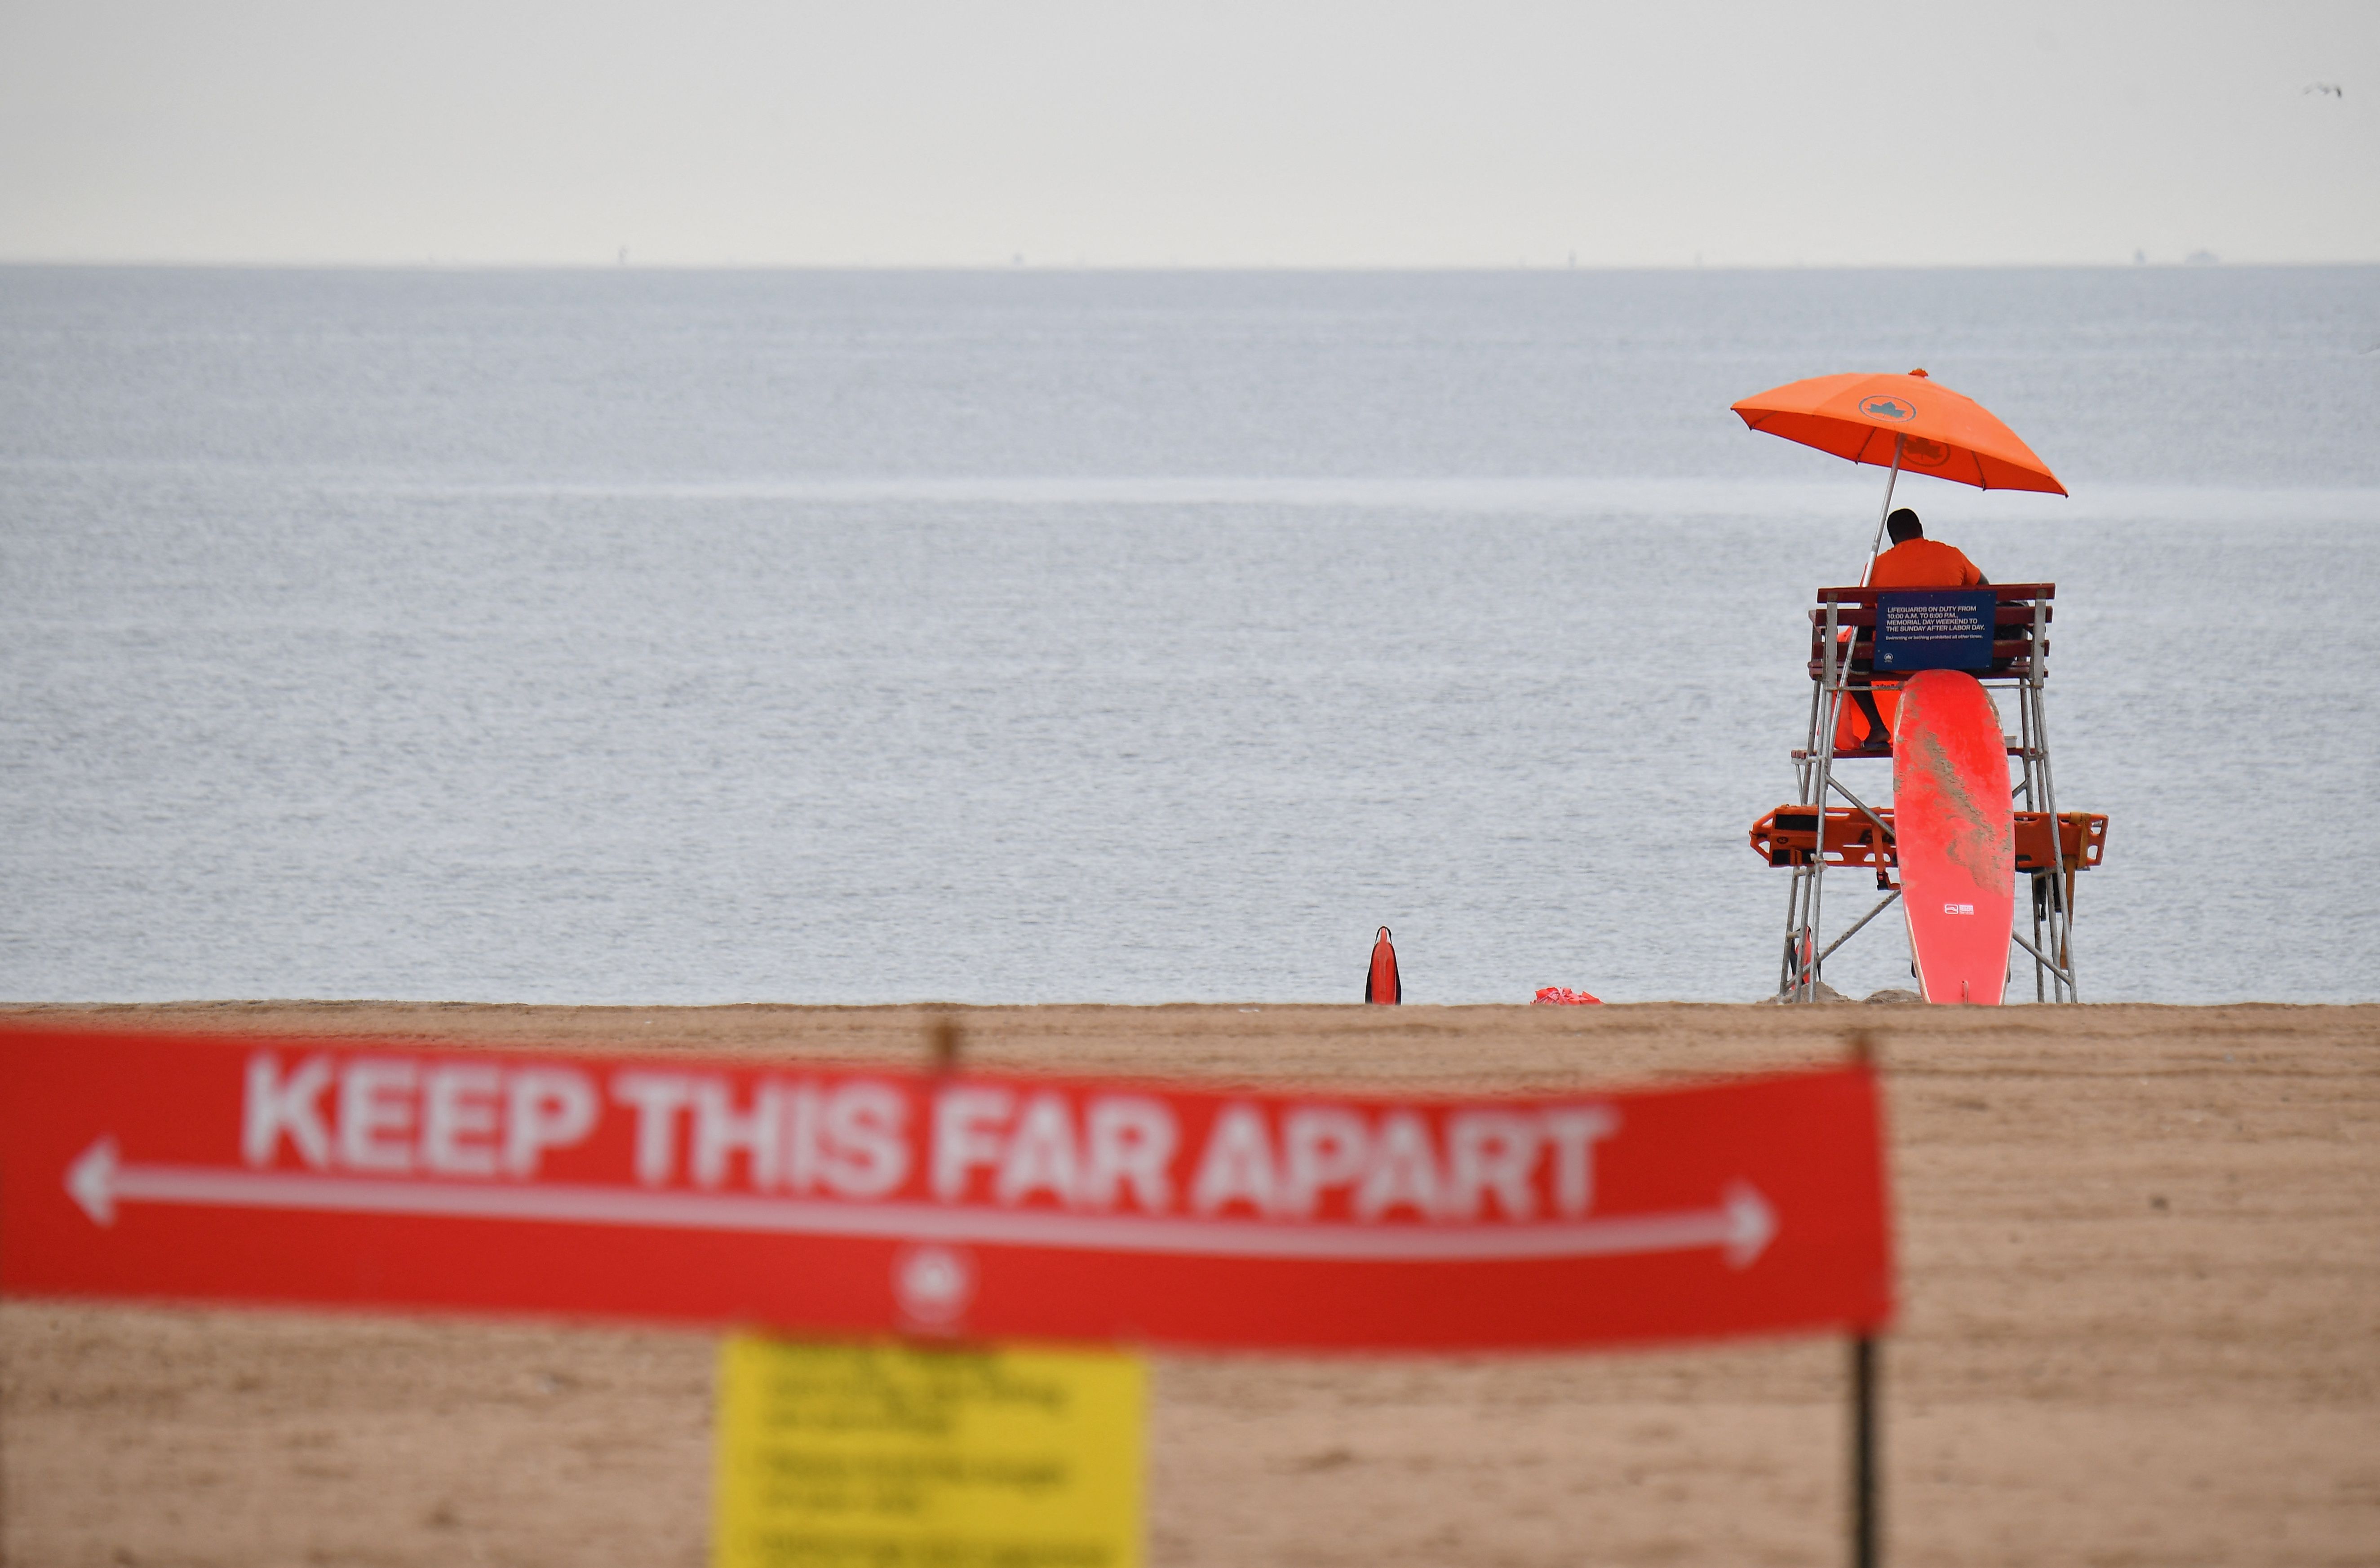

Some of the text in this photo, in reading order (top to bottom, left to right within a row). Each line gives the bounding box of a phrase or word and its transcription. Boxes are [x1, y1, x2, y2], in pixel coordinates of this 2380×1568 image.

[244, 1055, 1619, 1223] KEEP THIS FAR APART
